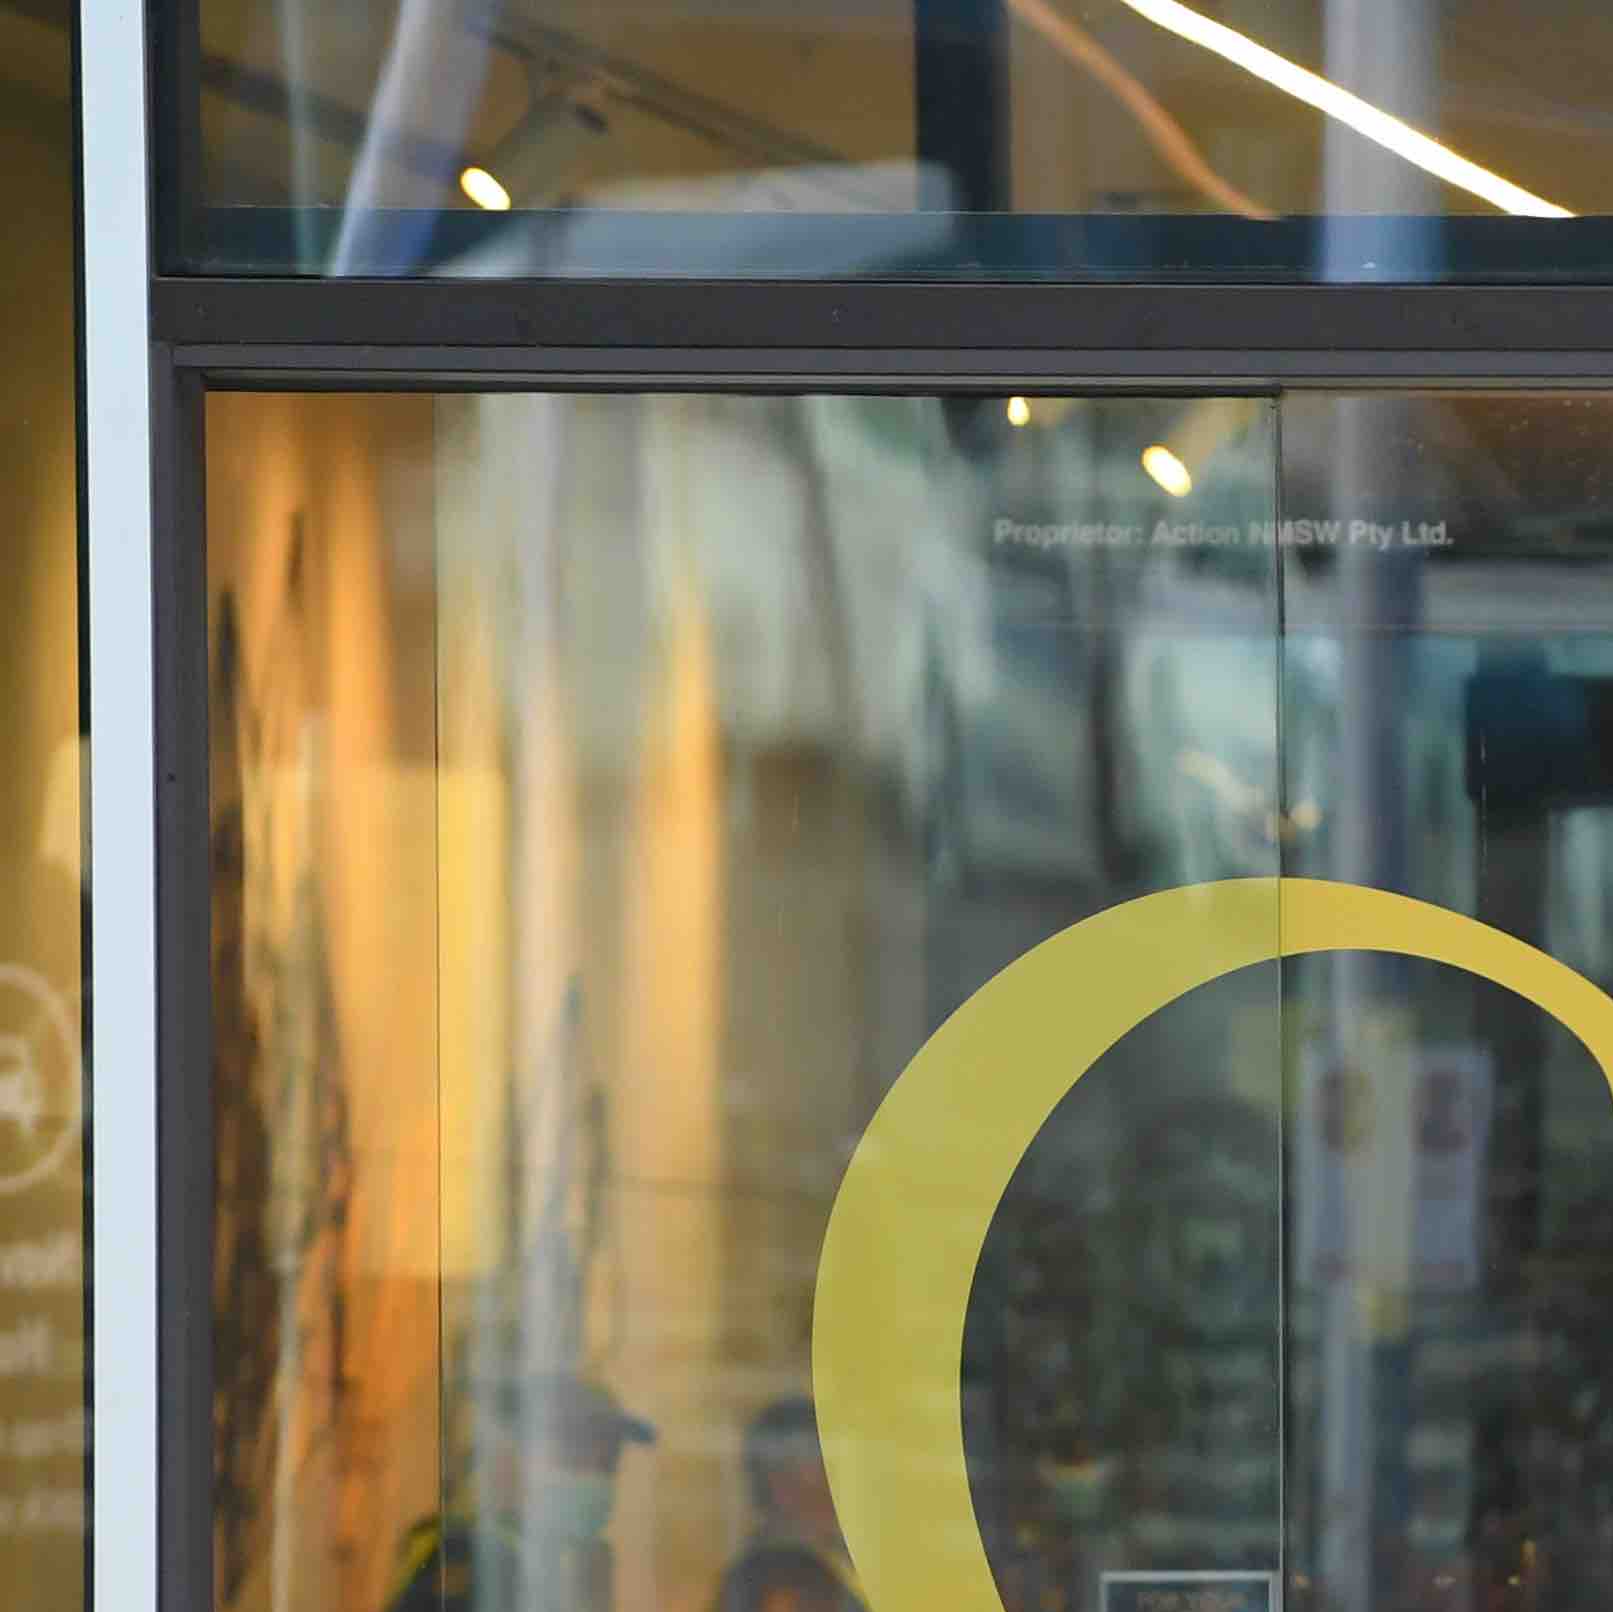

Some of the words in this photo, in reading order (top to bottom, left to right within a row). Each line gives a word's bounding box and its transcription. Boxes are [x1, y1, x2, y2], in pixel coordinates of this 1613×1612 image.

[993, 519, 1143, 550] Proprietor:
[1151, 519, 1240, 546] Action
[1349, 520, 1394, 551] Pty
[1401, 520, 1454, 546] Ltd.
